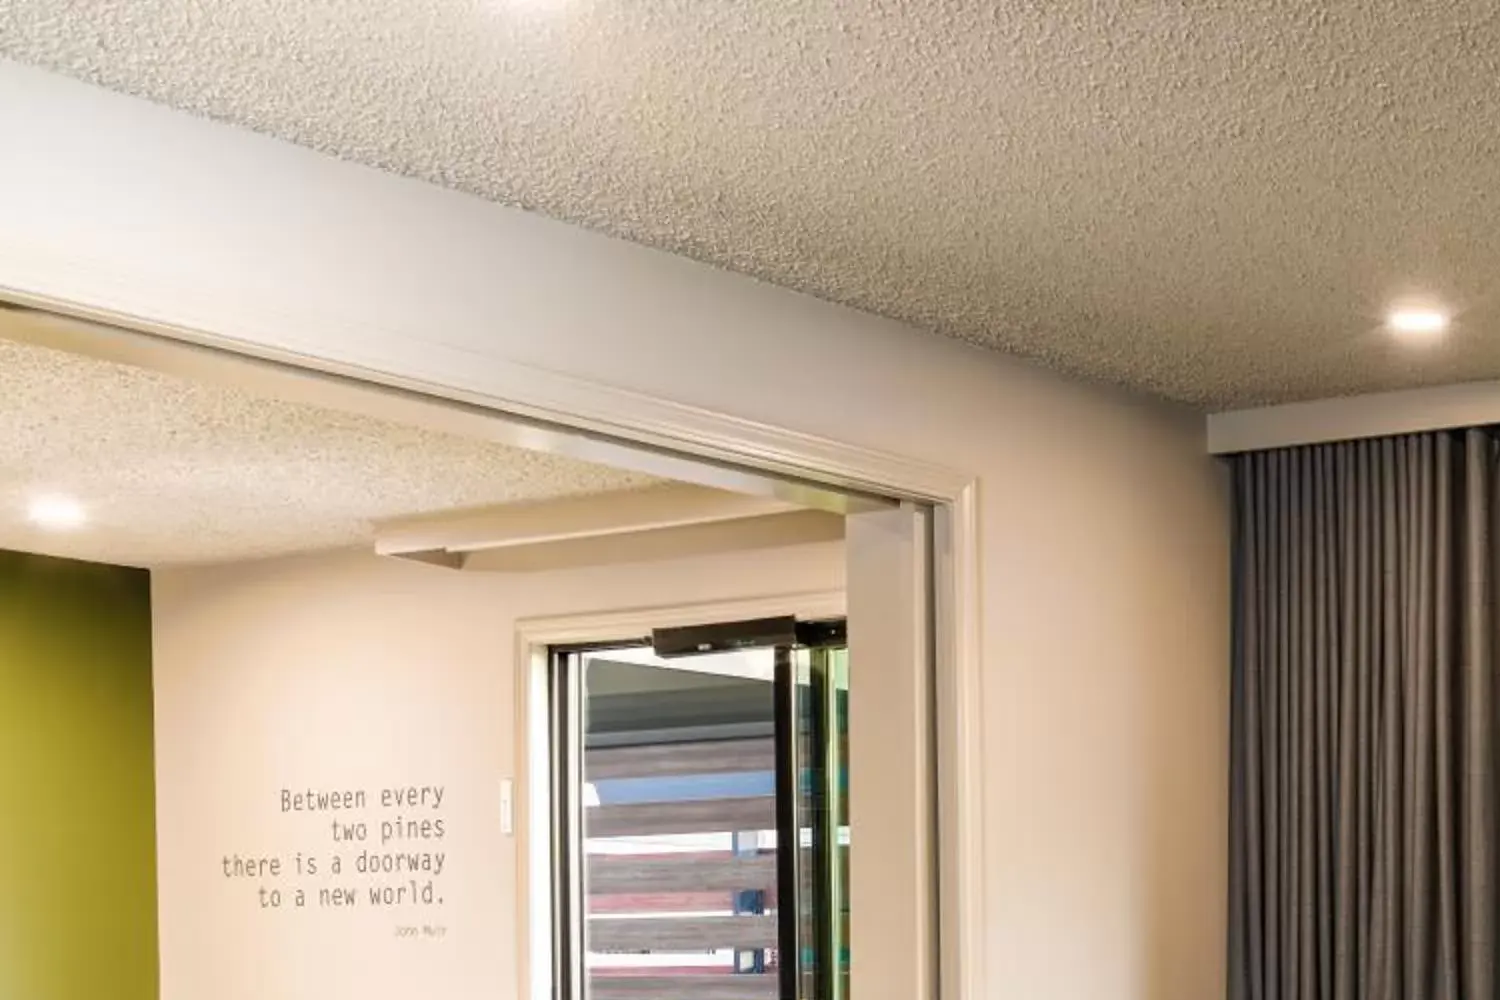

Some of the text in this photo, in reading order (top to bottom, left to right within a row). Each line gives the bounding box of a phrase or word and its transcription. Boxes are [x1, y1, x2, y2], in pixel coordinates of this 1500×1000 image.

[280, 784, 445, 813] Between every
[331, 815, 445, 844] two pines
[222, 849, 446, 878] there is a doorway
[257, 880, 445, 908] to a new world.
